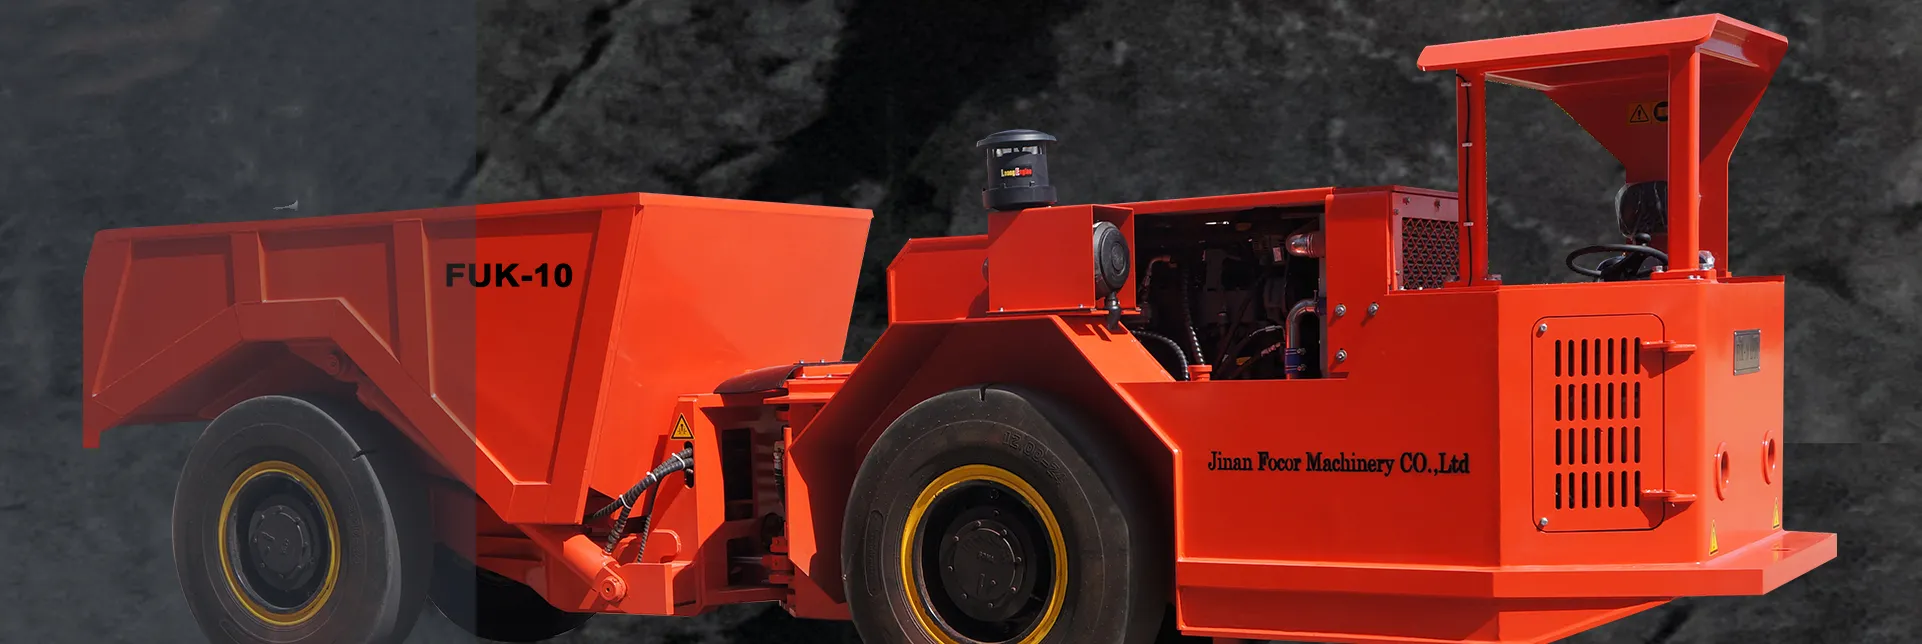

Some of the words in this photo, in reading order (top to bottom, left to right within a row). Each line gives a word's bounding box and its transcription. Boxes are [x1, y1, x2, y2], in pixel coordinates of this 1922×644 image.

[446, 263, 573, 287] FUK-10
[1208, 451, 1253, 471] Jinan
[1257, 451, 1302, 471] Focor
[1306, 452, 1395, 477] Machinery
